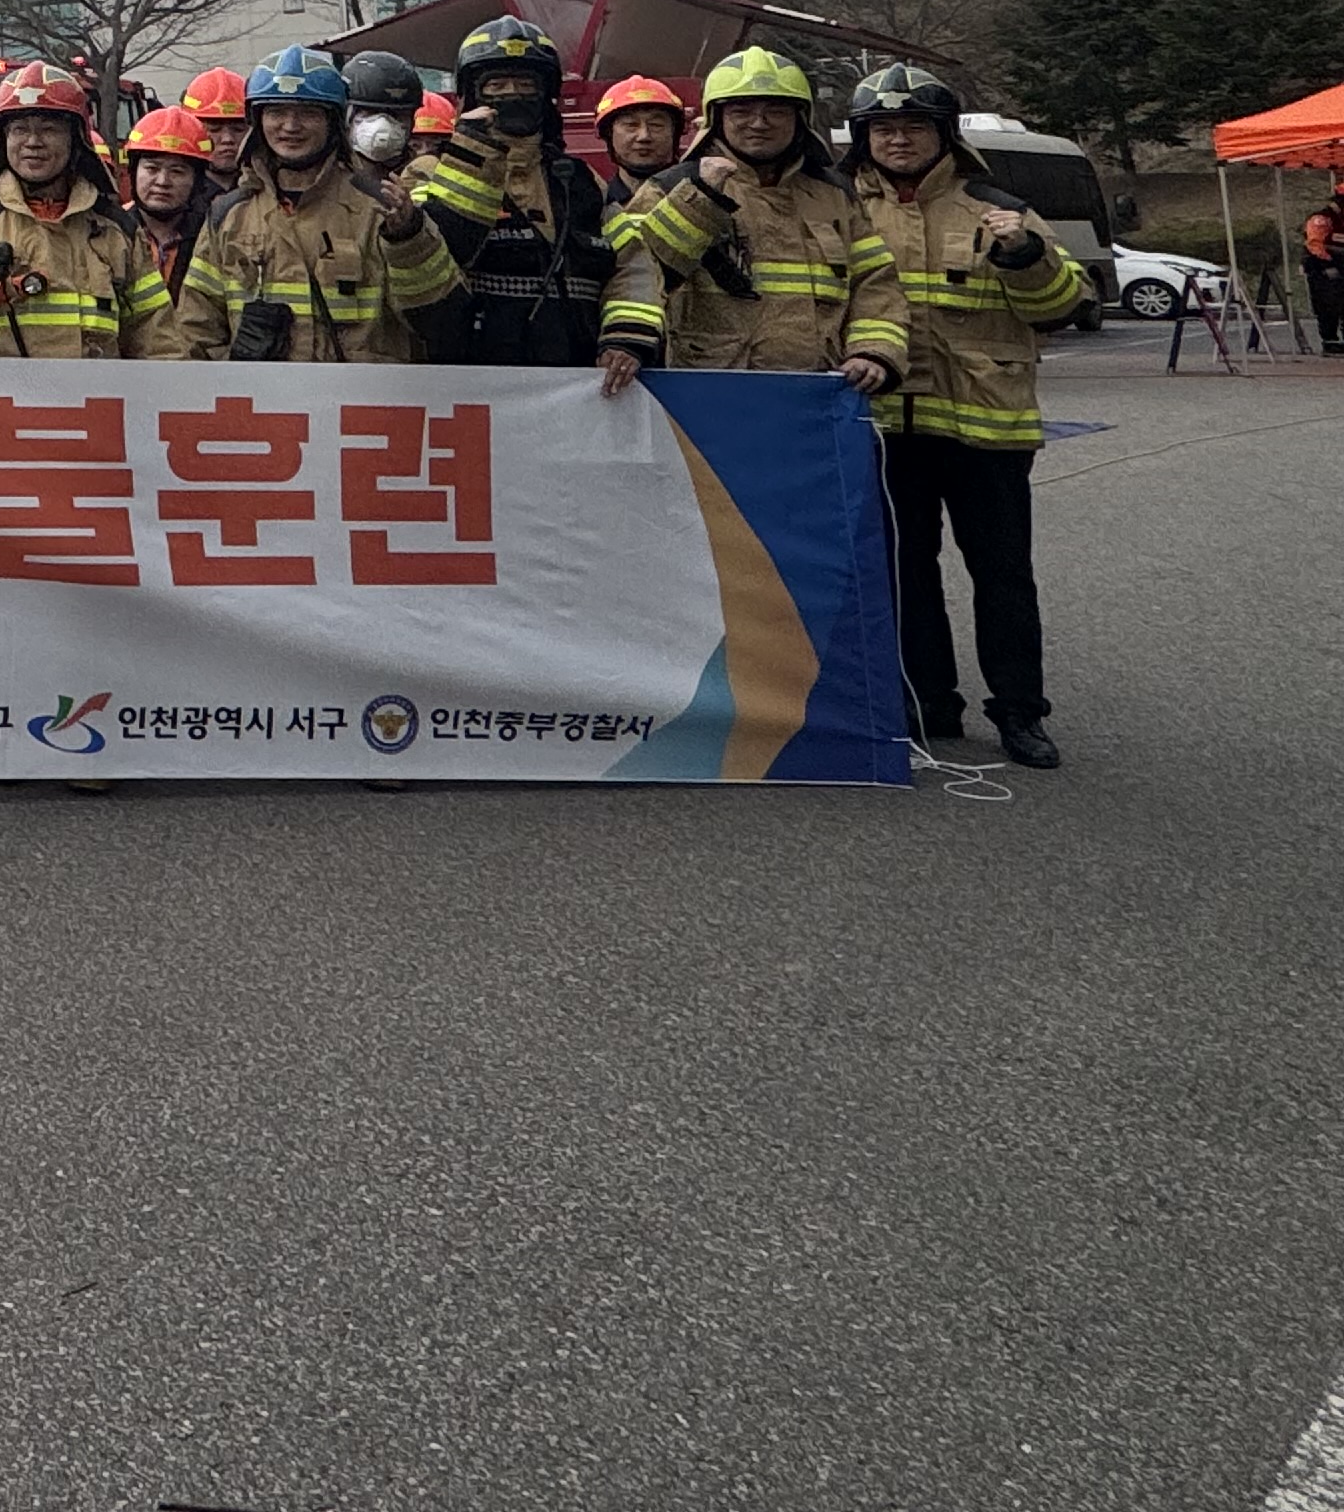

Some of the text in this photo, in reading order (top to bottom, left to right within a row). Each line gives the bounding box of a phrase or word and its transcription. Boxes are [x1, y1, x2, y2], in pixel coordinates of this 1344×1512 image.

[118, 706, 275, 740] 인천광역시
[285, 706, 348, 740] 서구
[430, 707, 654, 744] 인천중부경찰서
